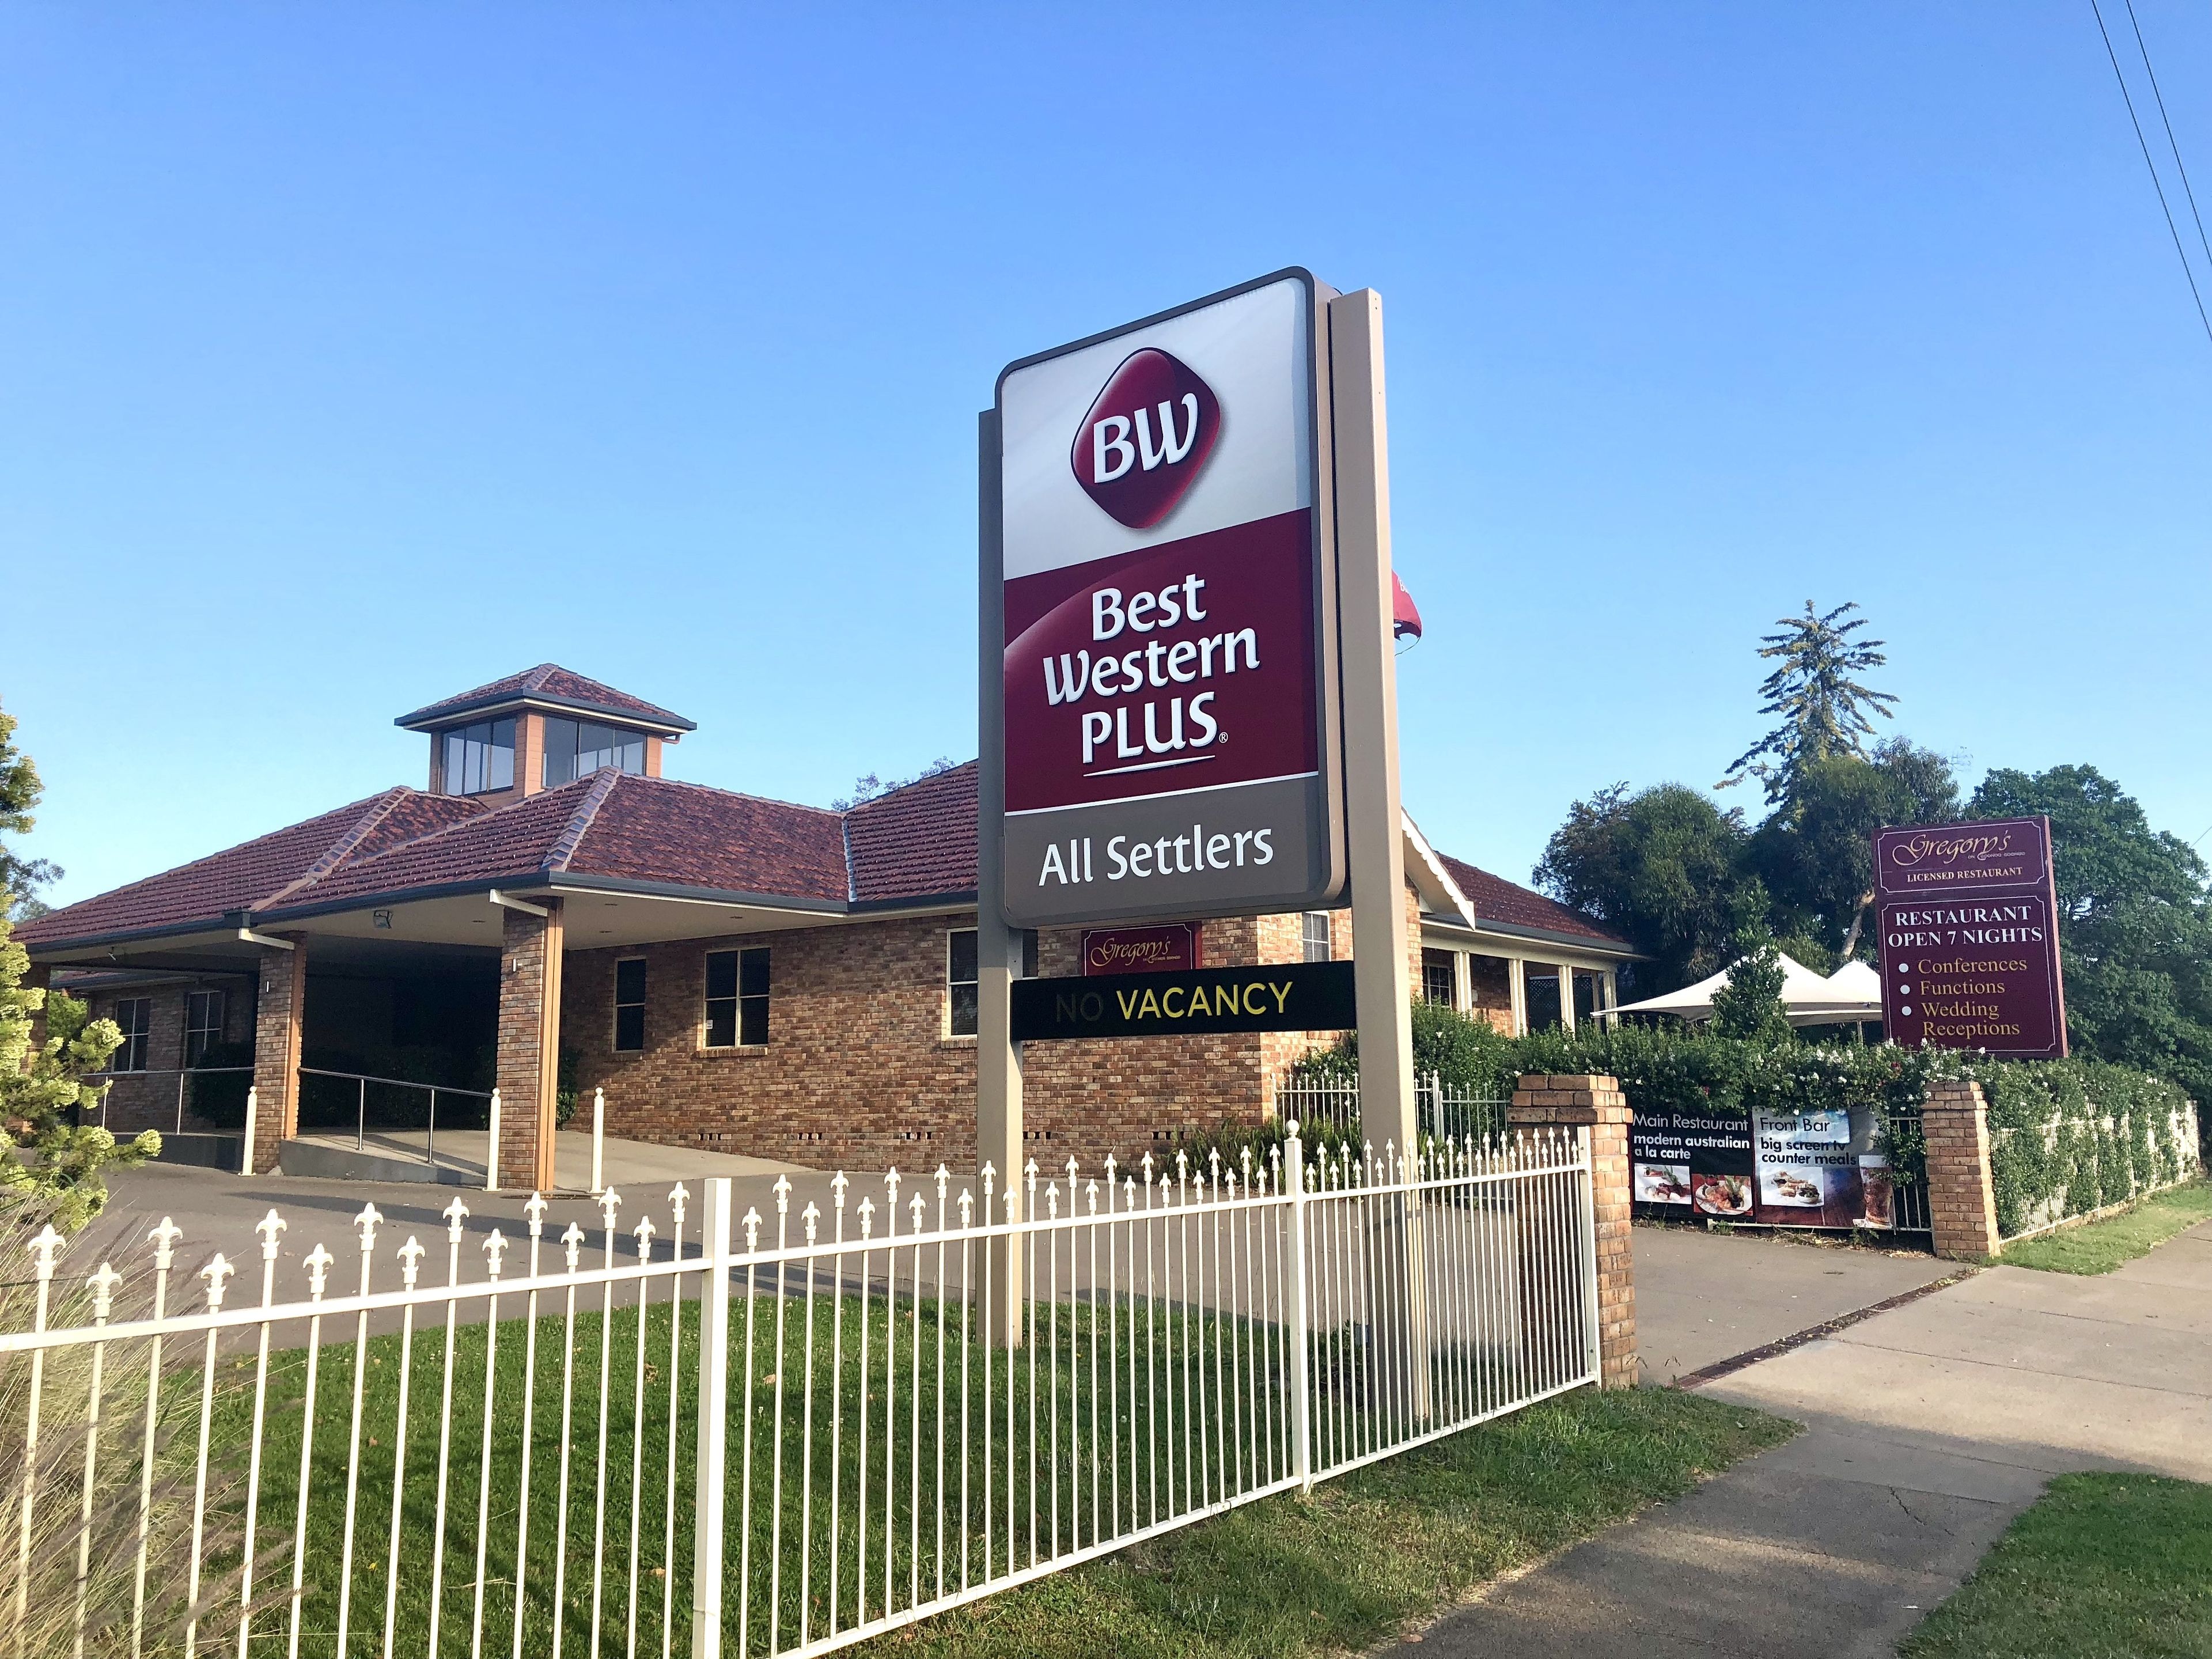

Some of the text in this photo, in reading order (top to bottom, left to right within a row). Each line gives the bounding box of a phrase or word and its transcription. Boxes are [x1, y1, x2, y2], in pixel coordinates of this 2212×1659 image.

[1093, 392, 1198, 483] BW
[1092, 574, 1207, 641] Best
[1043, 628, 1260, 706] Western
[1039, 824, 1274, 887] All Settlers
[1892, 830, 2011, 866] Gregory's
[1907, 866, 2022, 882] LICENSED RESTAURANT
[1895, 906, 2031, 926] RESTAURANT
[1888, 927, 2043, 948] OPEN 7 NIGHTS
[1090, 935, 1171, 967] Gregory's
[1918, 957, 2027, 975] Conferences
[1921, 979, 2005, 996] Functions
[1056, 981, 1293, 1023] NO VACANCY
[1922, 1001, 1999, 1020] Wedding
[1922, 1020, 2020, 1040] Receptions
[1633, 1112, 1748, 1131] Main Restaurant
[1760, 1117, 1830, 1132] Front Bar
[1634, 1132, 1750, 1149] modern australian
[1760, 1137, 1846, 1153] big screen tv
[1634, 1145, 1691, 1160] a la carte
[1762, 1152, 1857, 1165] counter meals
